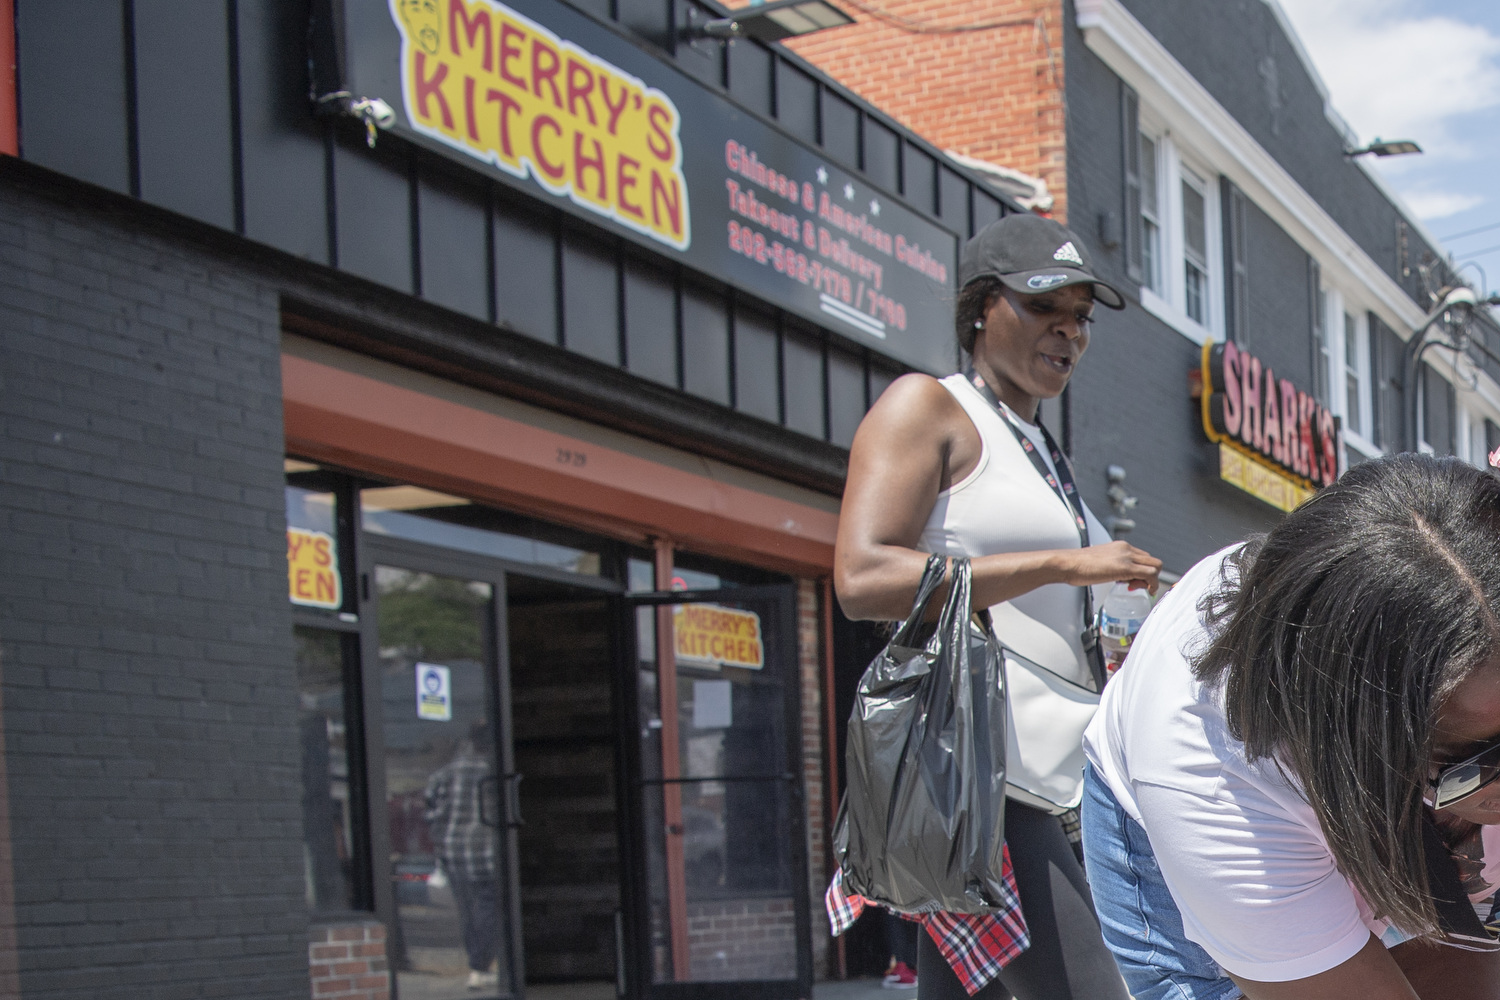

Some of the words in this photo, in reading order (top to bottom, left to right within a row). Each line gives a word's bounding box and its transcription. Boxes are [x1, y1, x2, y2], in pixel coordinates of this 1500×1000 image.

[414, 50, 682, 236] KITCHEN
[449, 0, 673, 162] MERRY'S
[725, 139, 799, 203] Chinese
[802, 182, 815, 212] &
[818, 191, 893, 255] American
[894, 234, 948, 283] Cuisine
[726, 178, 800, 242] Takeout
[803, 220, 816, 250] &
[818, 227, 883, 290] Delivery
[1223, 339, 1336, 488] SHARK'S
[677, 631, 760, 665] KITCHEN
